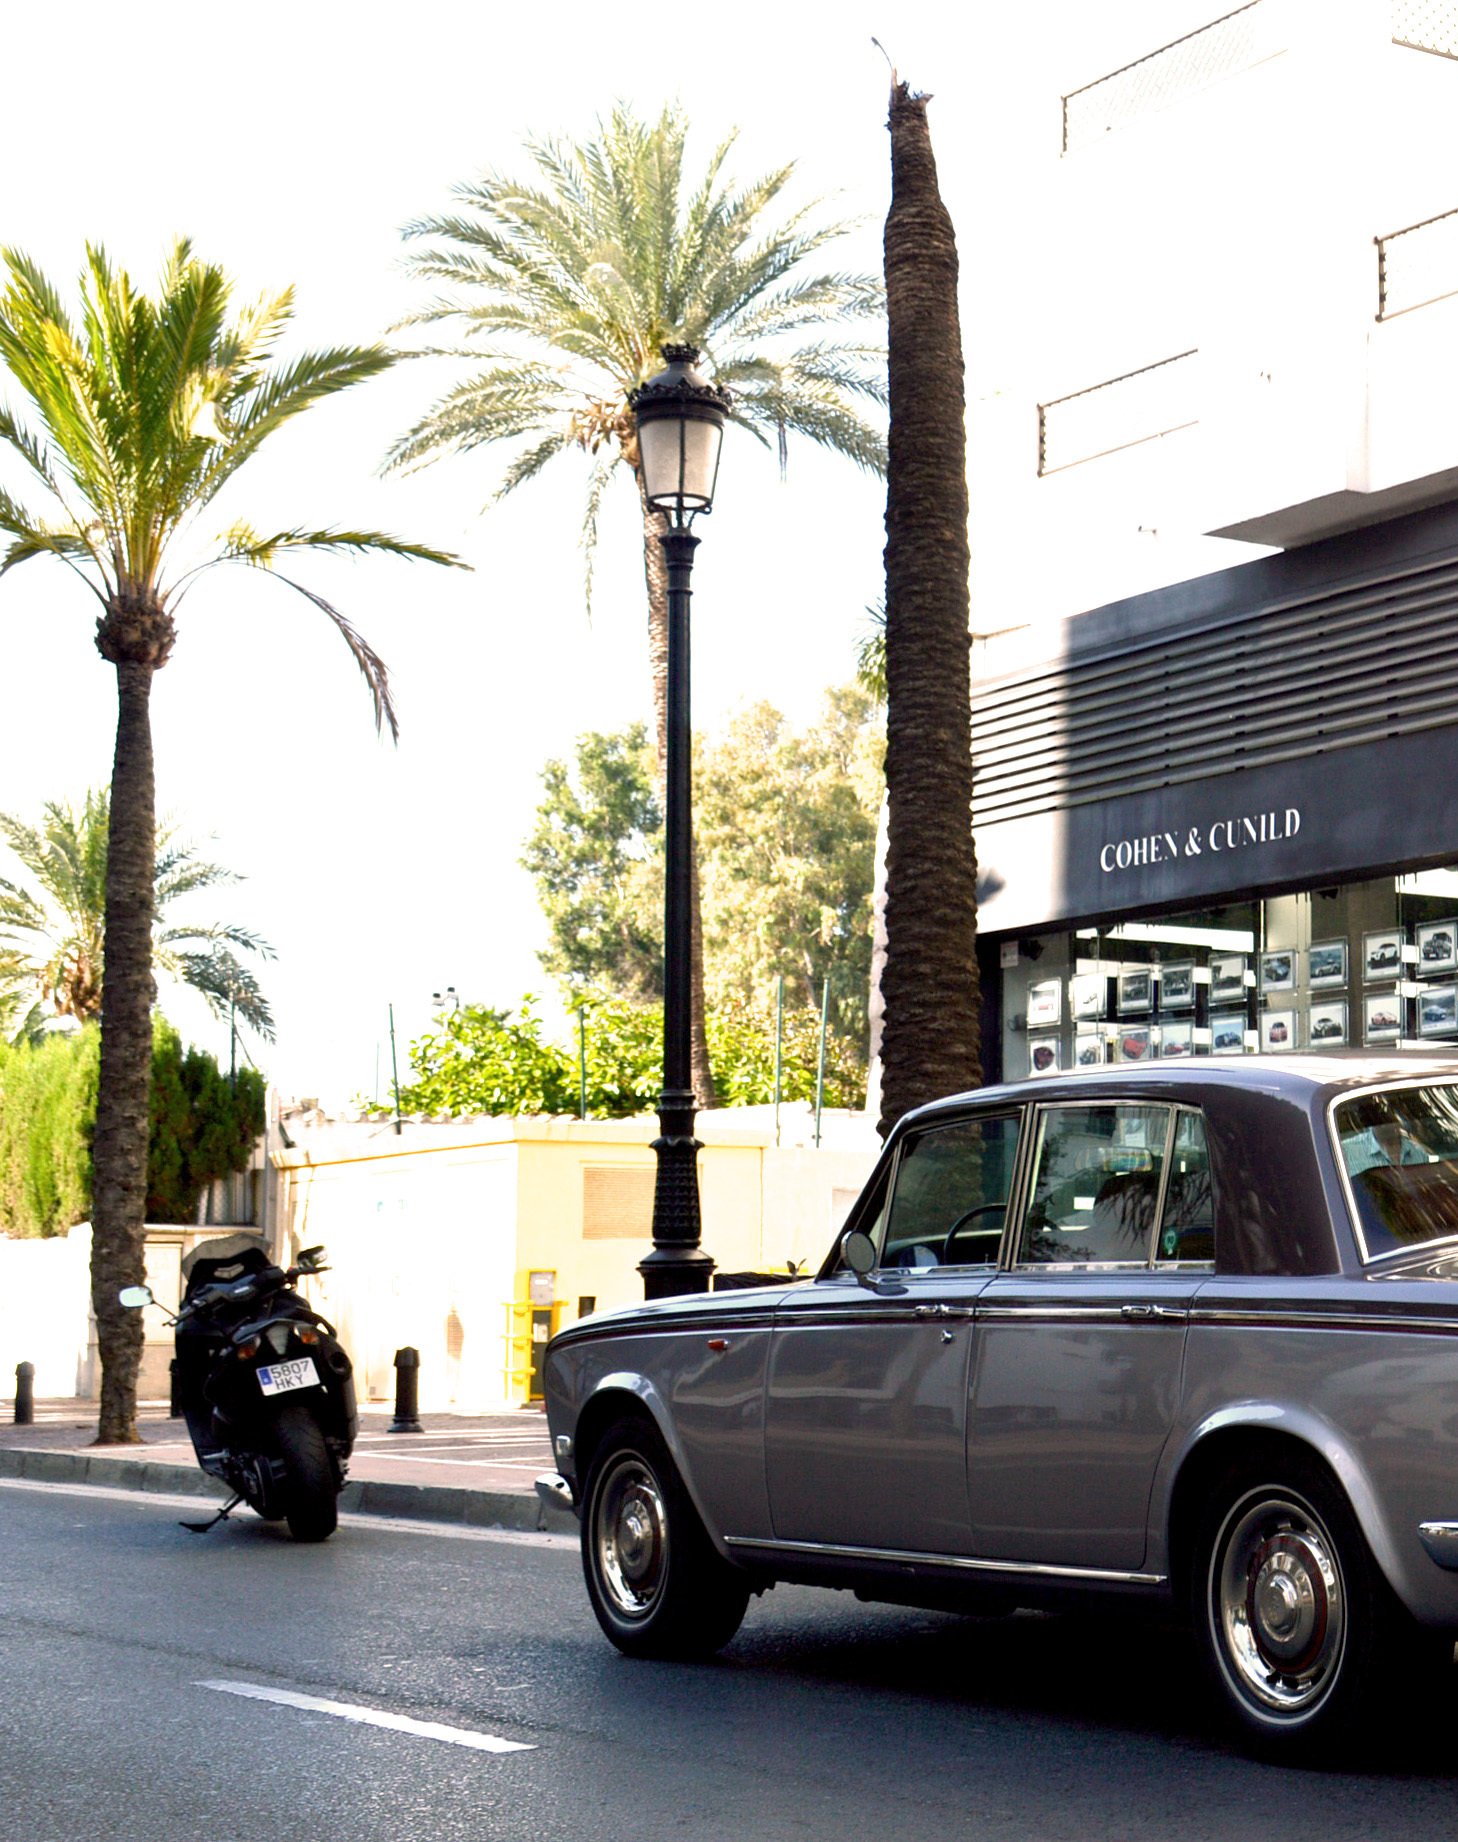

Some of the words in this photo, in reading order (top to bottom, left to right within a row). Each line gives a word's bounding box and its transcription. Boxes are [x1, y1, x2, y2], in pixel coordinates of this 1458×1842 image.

[1100, 830, 1178, 872] COHEN
[1184, 826, 1202, 857] &
[1209, 808, 1300, 851] CUNILD
[270, 1360, 309, 1379] 5807
[274, 1374, 303, 1390] HKY
